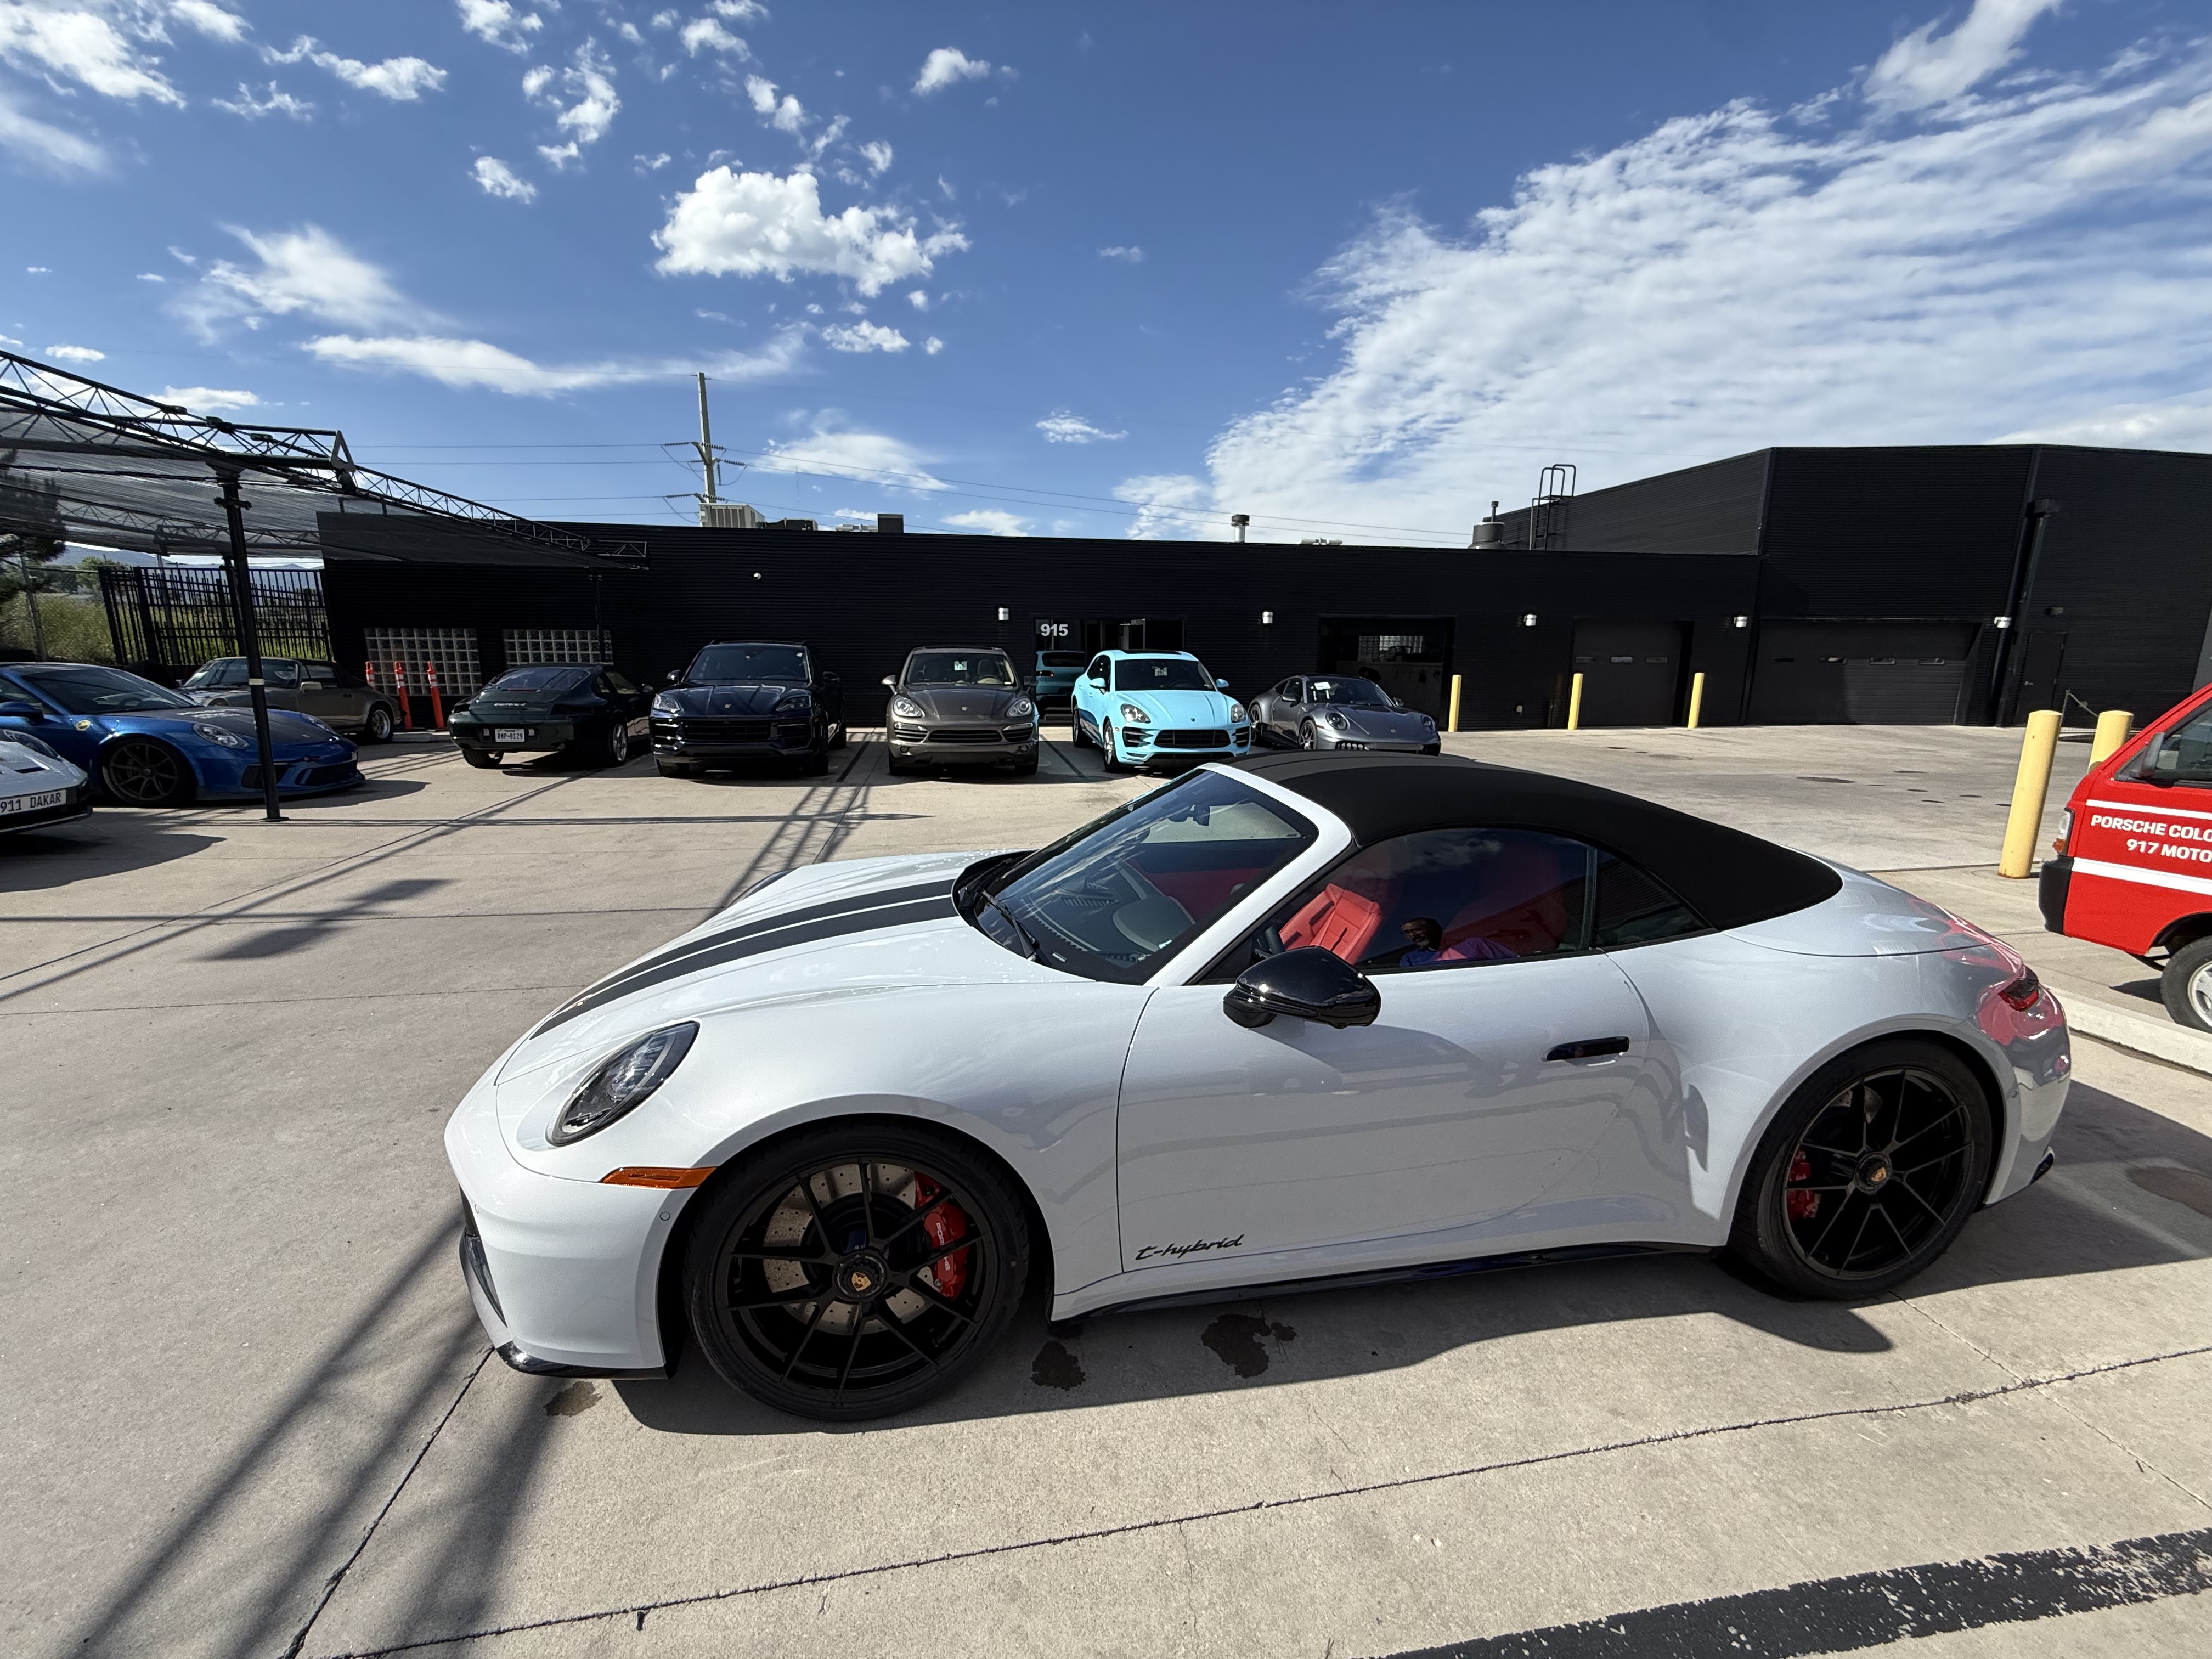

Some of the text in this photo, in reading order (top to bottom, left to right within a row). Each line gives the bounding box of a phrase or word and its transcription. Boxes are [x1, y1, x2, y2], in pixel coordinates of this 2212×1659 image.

[1041, 624, 1069, 636] 915
[0, 792, 61, 813] 911 DAKAR
[2091, 815, 2167, 836] PORSCHE
[2126, 839, 2212, 863] 917 MOTO
[935, 1222, 951, 1271] PORHE
[1135, 1234, 1245, 1261] t-hybrid
